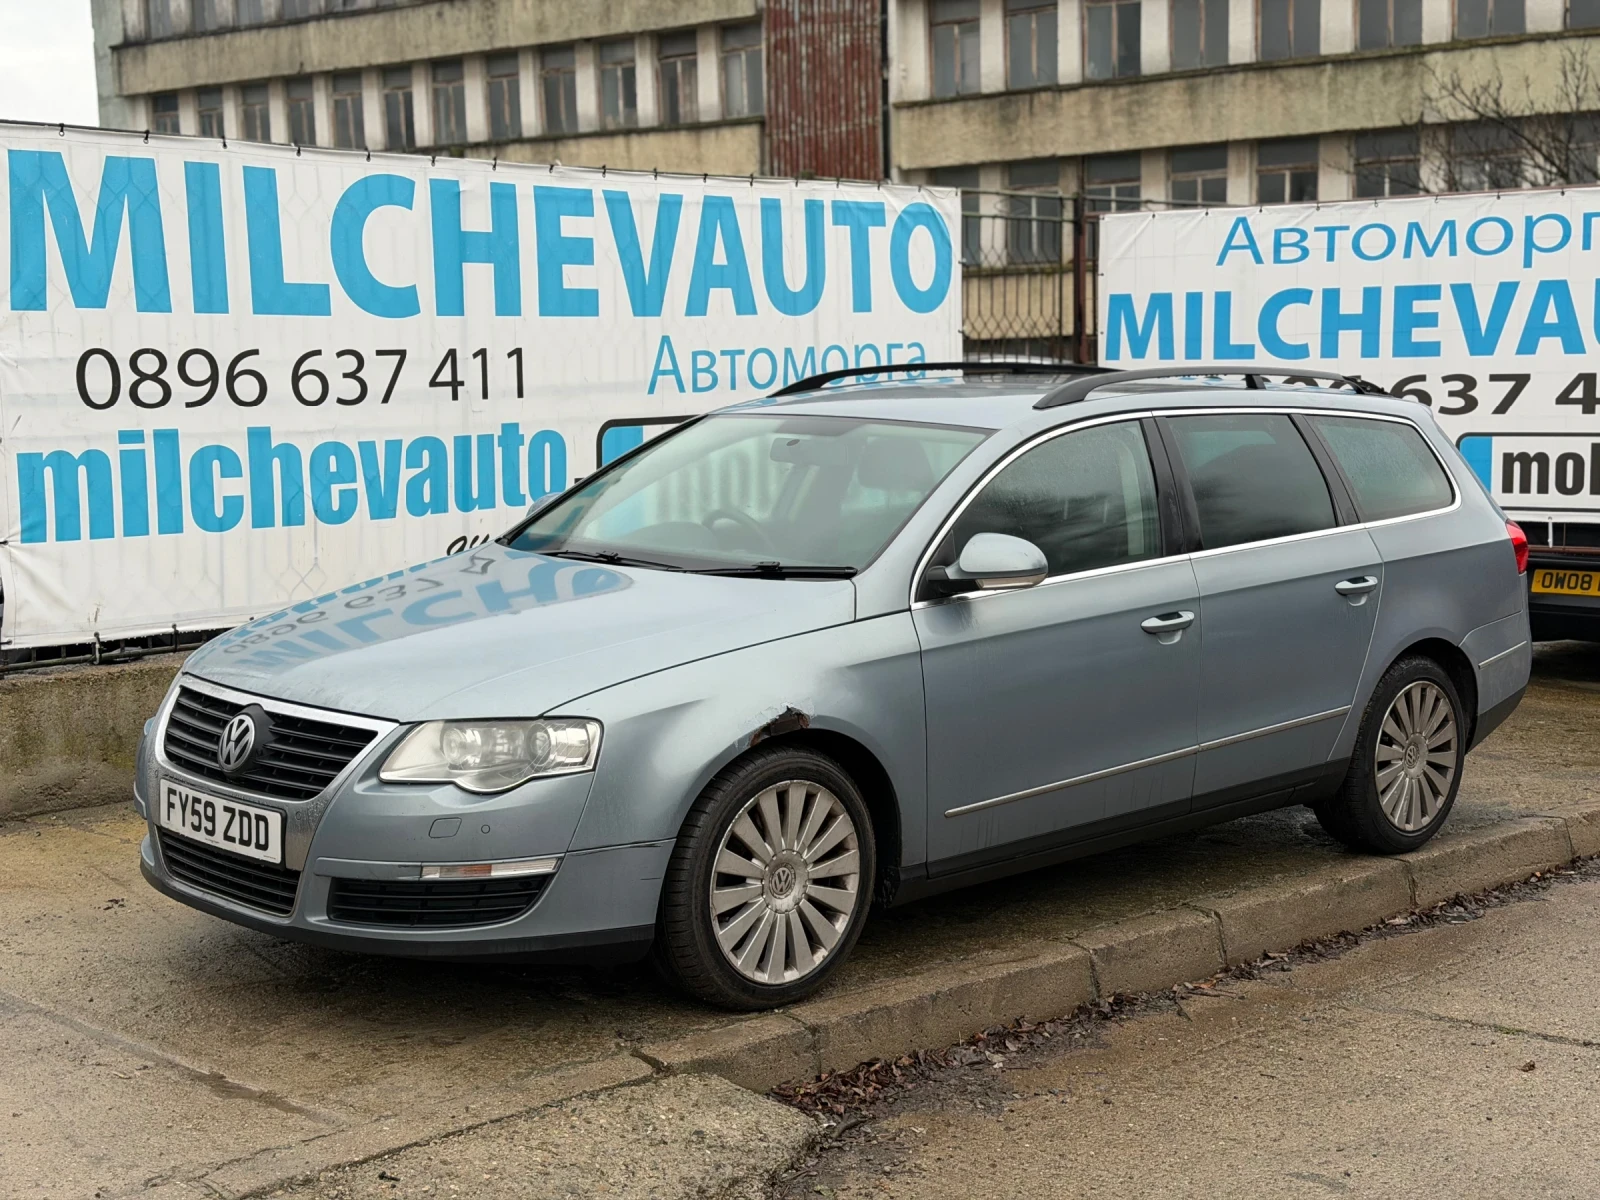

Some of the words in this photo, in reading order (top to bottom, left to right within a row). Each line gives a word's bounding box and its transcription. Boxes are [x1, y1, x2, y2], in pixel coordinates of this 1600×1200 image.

[7, 148, 953, 319] MILCHEVAUTO
[1105, 278, 1600, 361] MILCHEVA
[75, 348, 269, 411] 0896
[290, 348, 408, 408] 637
[428, 346, 525, 402] 411
[1541, 571, 1593, 591] OW08
[166, 786, 216, 837] FY59
[222, 804, 270, 852] ZDD
